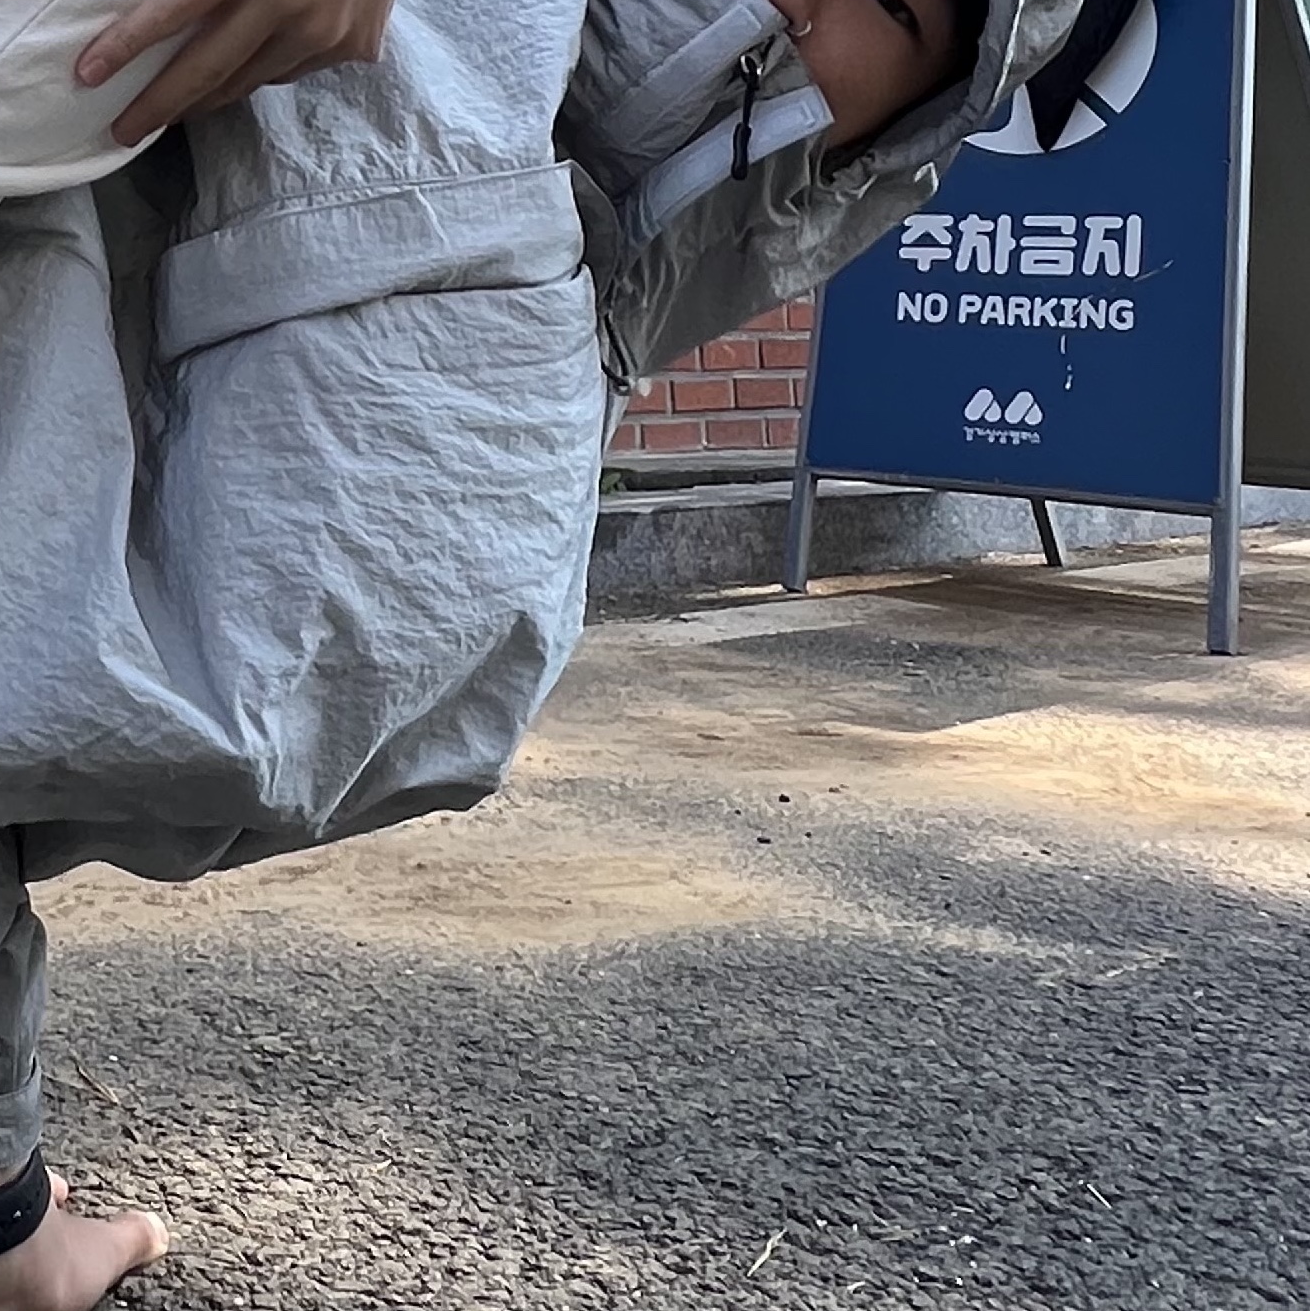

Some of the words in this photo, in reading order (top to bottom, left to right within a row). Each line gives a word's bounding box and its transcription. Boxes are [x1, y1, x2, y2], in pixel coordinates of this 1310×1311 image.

[898, 214, 1143, 278] 주차금지
[897, 291, 948, 323] NO
[958, 294, 1135, 331] PARKING
